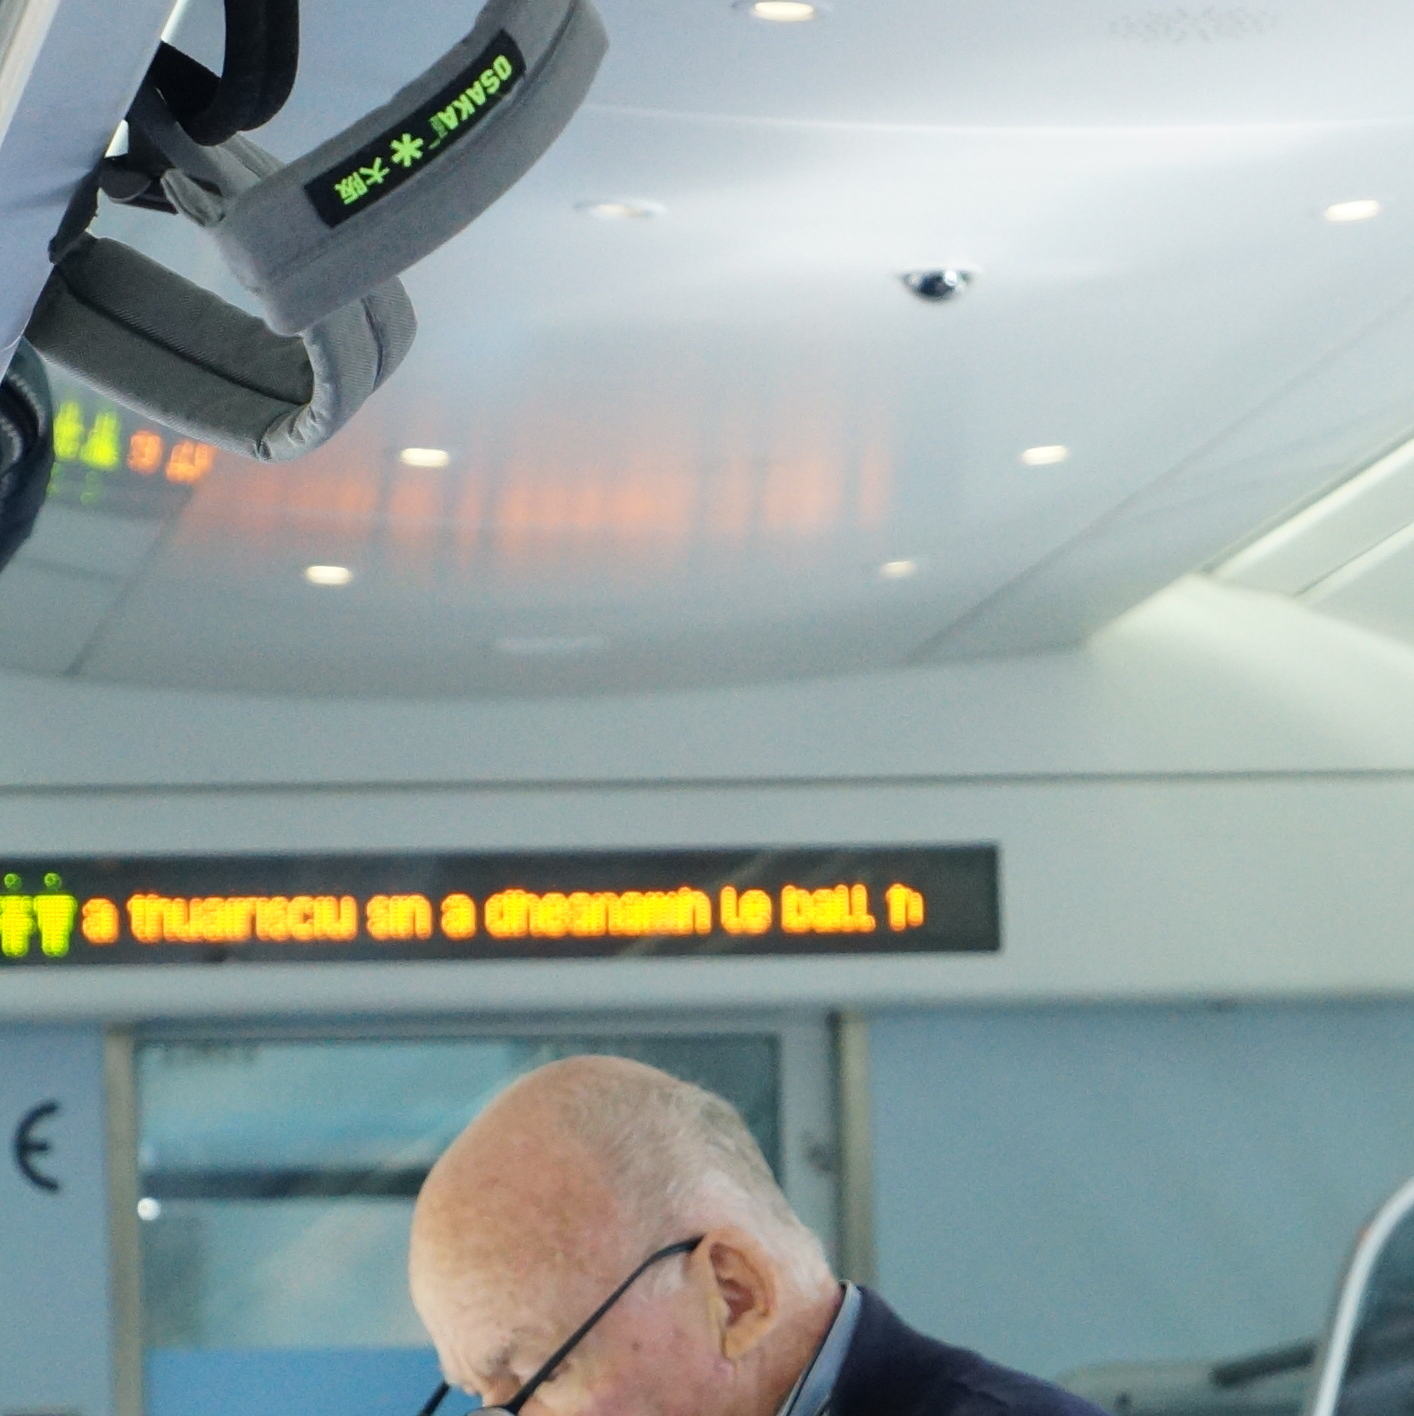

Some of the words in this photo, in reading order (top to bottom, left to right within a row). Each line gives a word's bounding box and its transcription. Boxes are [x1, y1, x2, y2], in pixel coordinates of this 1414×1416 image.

[334, 156, 390, 205] 大阪
[81, 897, 119, 943] a
[440, 893, 477, 939] a
